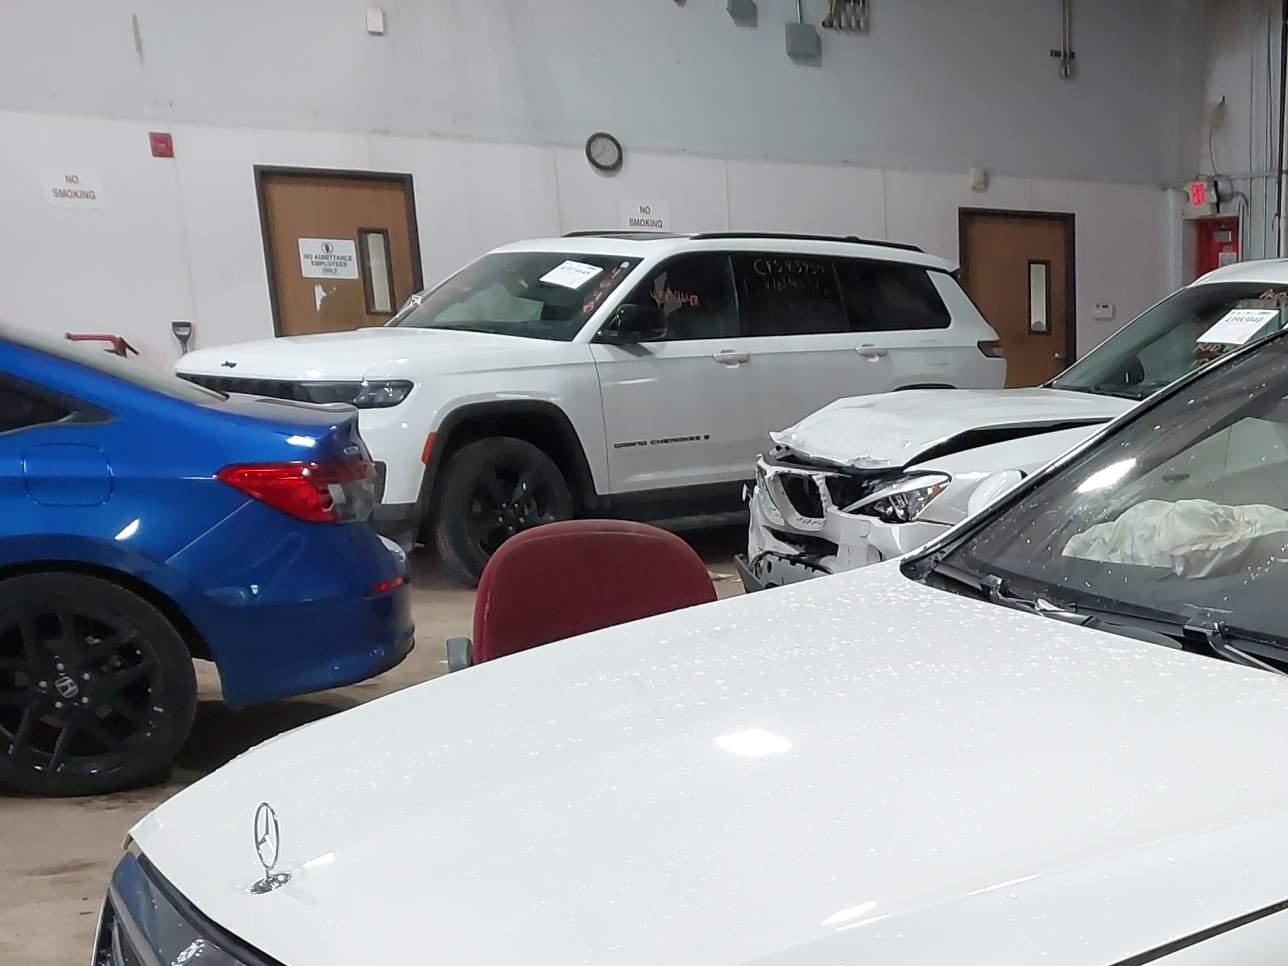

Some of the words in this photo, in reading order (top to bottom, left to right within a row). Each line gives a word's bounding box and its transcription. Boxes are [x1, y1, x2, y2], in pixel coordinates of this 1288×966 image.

[64, 174, 80, 184] NO
[52, 188, 96, 200] SMOKING
[639, 205, 651, 215] NO
[311, 260, 348, 268] EMPLOYEES
